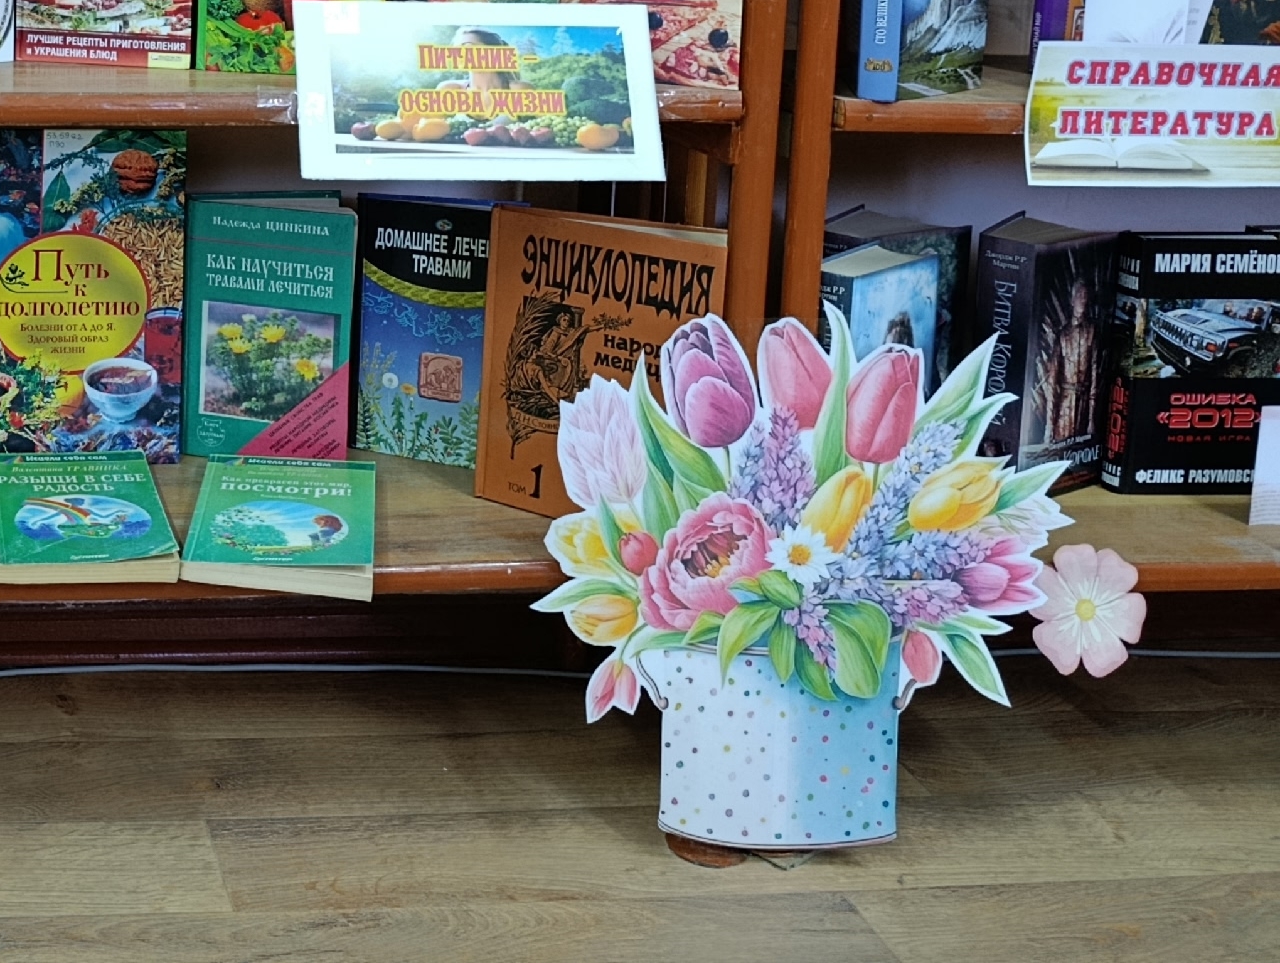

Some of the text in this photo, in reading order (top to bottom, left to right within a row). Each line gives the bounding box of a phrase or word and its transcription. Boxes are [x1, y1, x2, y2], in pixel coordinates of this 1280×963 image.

[26, 33, 186, 52] ЛУЧШИЕ РЕЦЕПТЫ ПРИГОТОВЛЕНИЯ
[875, 29, 885, 45] СТО
[34, 47, 117, 61] УКРАШЕНИЯ БЛЮД
[1066, 60, 1280, 87] СПРАВОЧНАЯ
[400, 91, 565, 117] ОСНОВА ЖИЗНИ
[1058, 110, 1276, 138] ЛИТЕРАТУРА
[213, 216, 261, 230] Надежда
[375, 227, 449, 254] ДОМАШНЕЕ
[32, 249, 110, 286] Путь
[206, 254, 236, 270] КАК
[412, 254, 471, 279] ТРАВАМИ
[1155, 253, 1211, 273] МАРИЯ
[521, 235, 716, 321] ЭНЦИКЛОПЕДИЯ
[992, 280, 1017, 336] БИТВА
[1170, 393, 1256, 405] ОШИБКА
[100, 473, 146, 483] СЕБЕ
[1135, 469, 1185, 484] ФЕЛИКС
[33, 483, 115, 493] РАДОСТЬ
